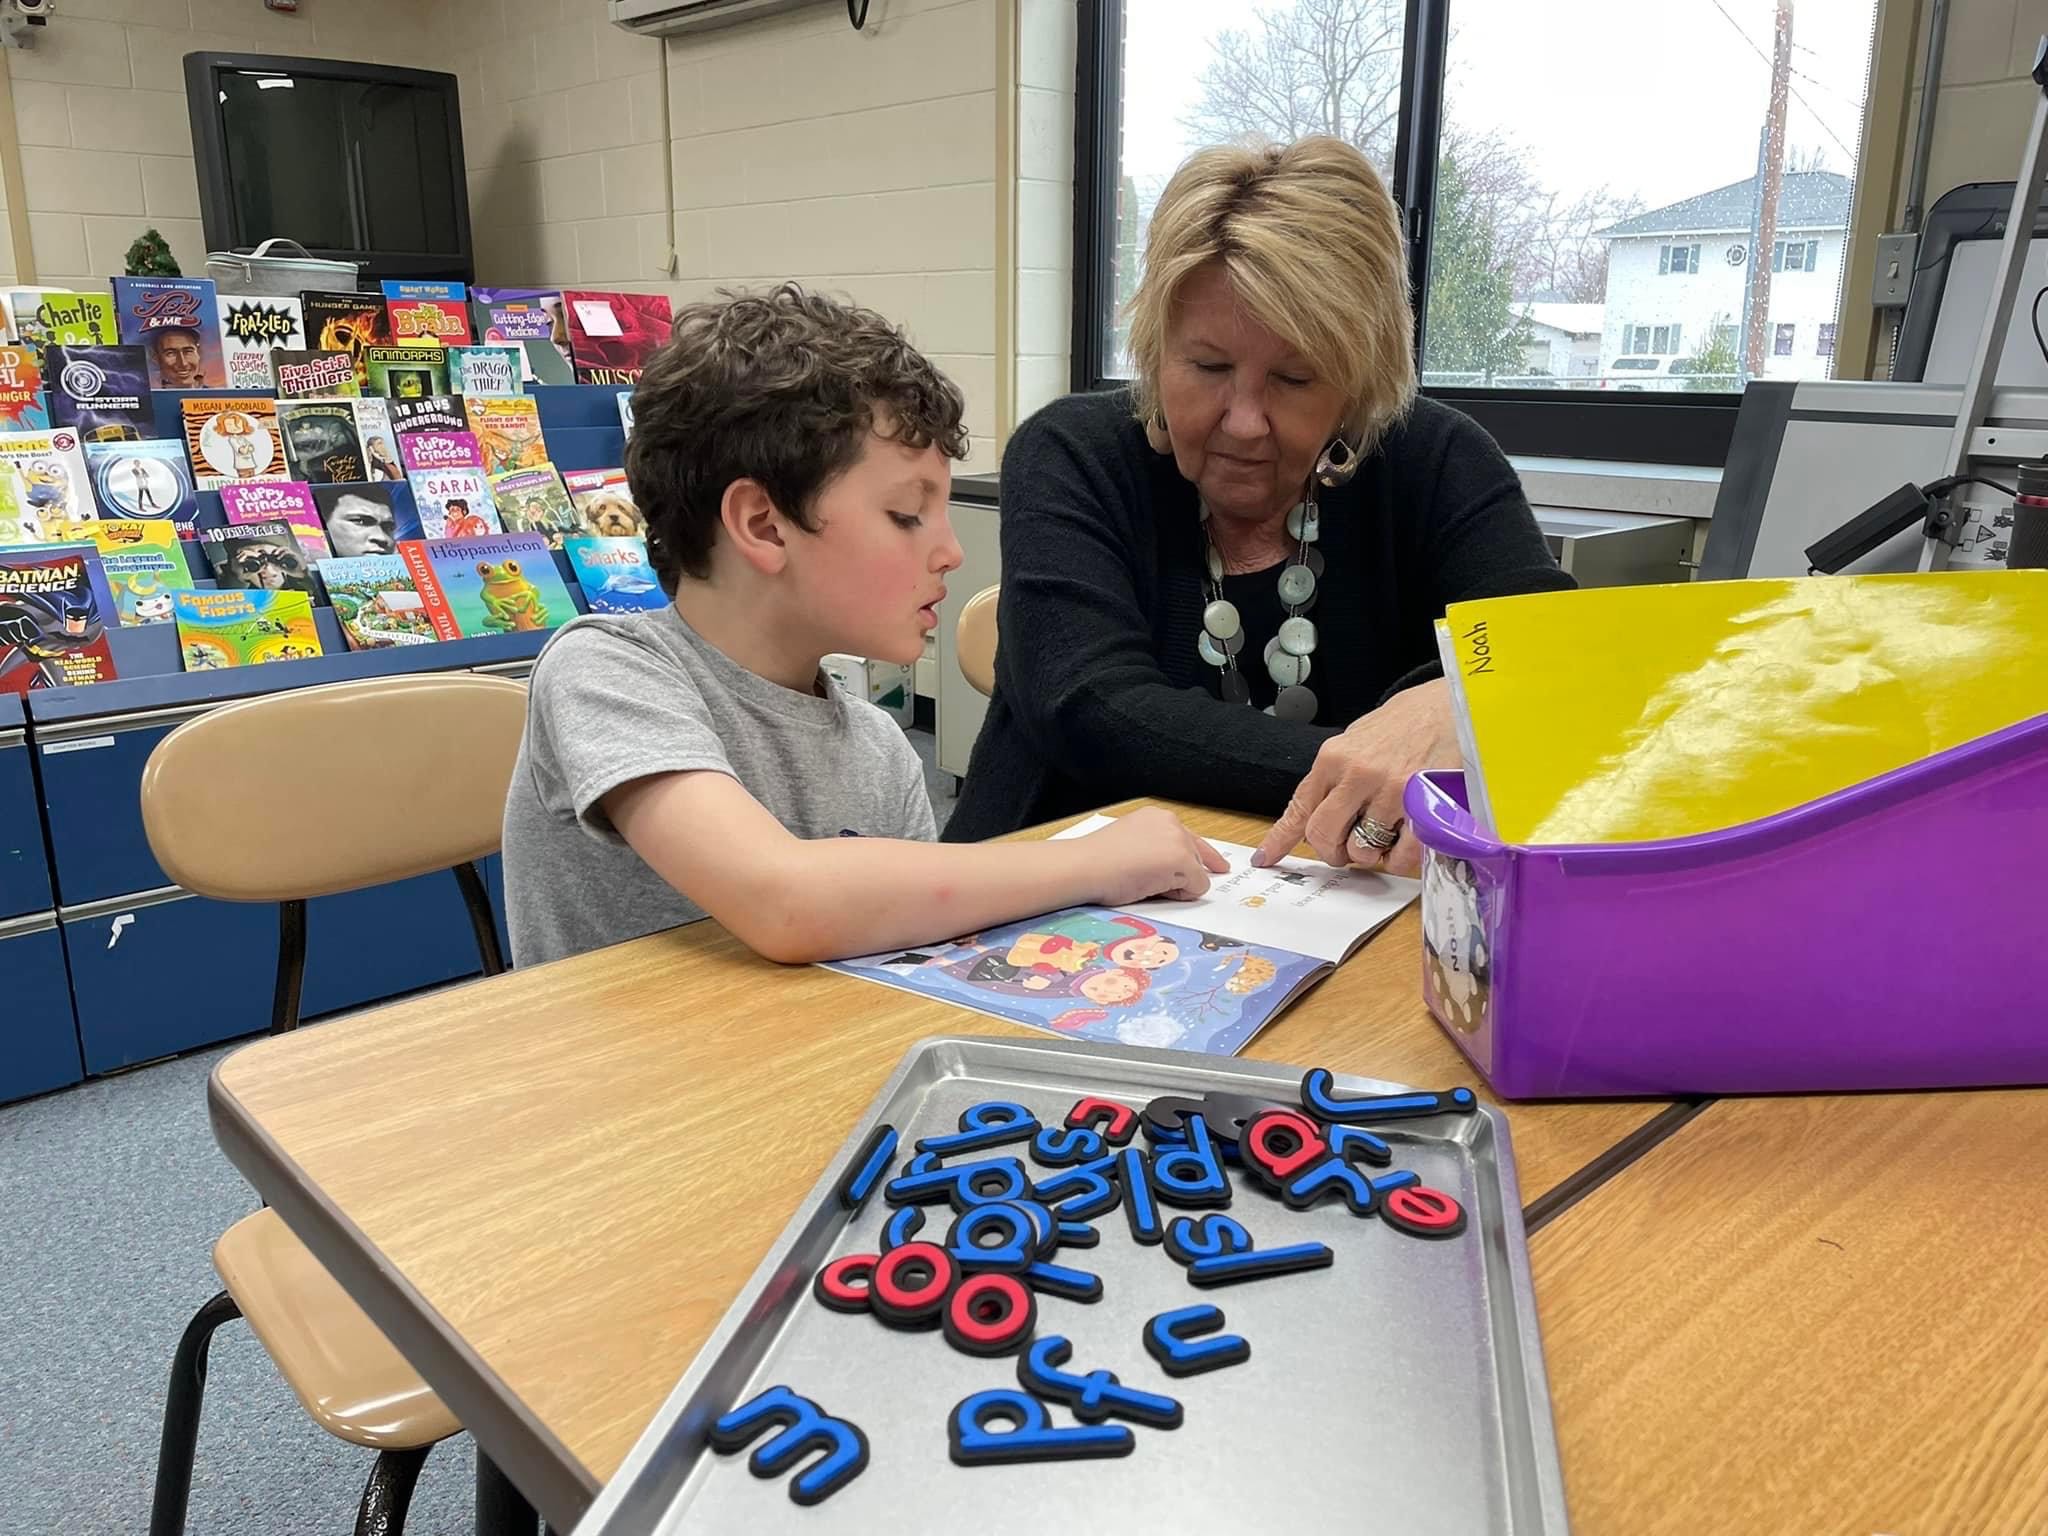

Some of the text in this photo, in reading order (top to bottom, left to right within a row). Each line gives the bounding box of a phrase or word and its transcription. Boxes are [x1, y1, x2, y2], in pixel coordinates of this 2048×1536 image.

[132, 289, 202, 319] Ted
[310, 301, 350, 310] HUNGER
[36, 298, 102, 328] Charlie
[162, 316, 183, 327] ME
[493, 311, 547, 327] Cutting-Edge
[232, 311, 291, 337] FRAZZLED
[505, 325, 541, 338] Medicine
[372, 350, 442, 361] ANIMORPHS
[280, 365, 310, 380] Five
[282, 370, 353, 394] Thrillers
[471, 377, 505, 393] THIEF
[76, 402, 140, 410] RUNNERS
[192, 402, 222, 411] MEGAN
[415, 398, 450, 414] DAYS
[393, 413, 464, 433] UNDERGROUND
[412, 446, 472, 463] Princess
[427, 478, 480, 495] SARAI
[235, 496, 304, 513] Princess
[207, 524, 286, 542] 10 TRUE TALES
[431, 539, 542, 560] Hoppameleon
[408, 545, 441, 607] GERAGHTY
[438, 612, 457, 641] PAUL
[1461, 621, 1495, 676] Noah
[1446, 905, 1461, 973] Noah
[713, 1383, 864, 1500] m
